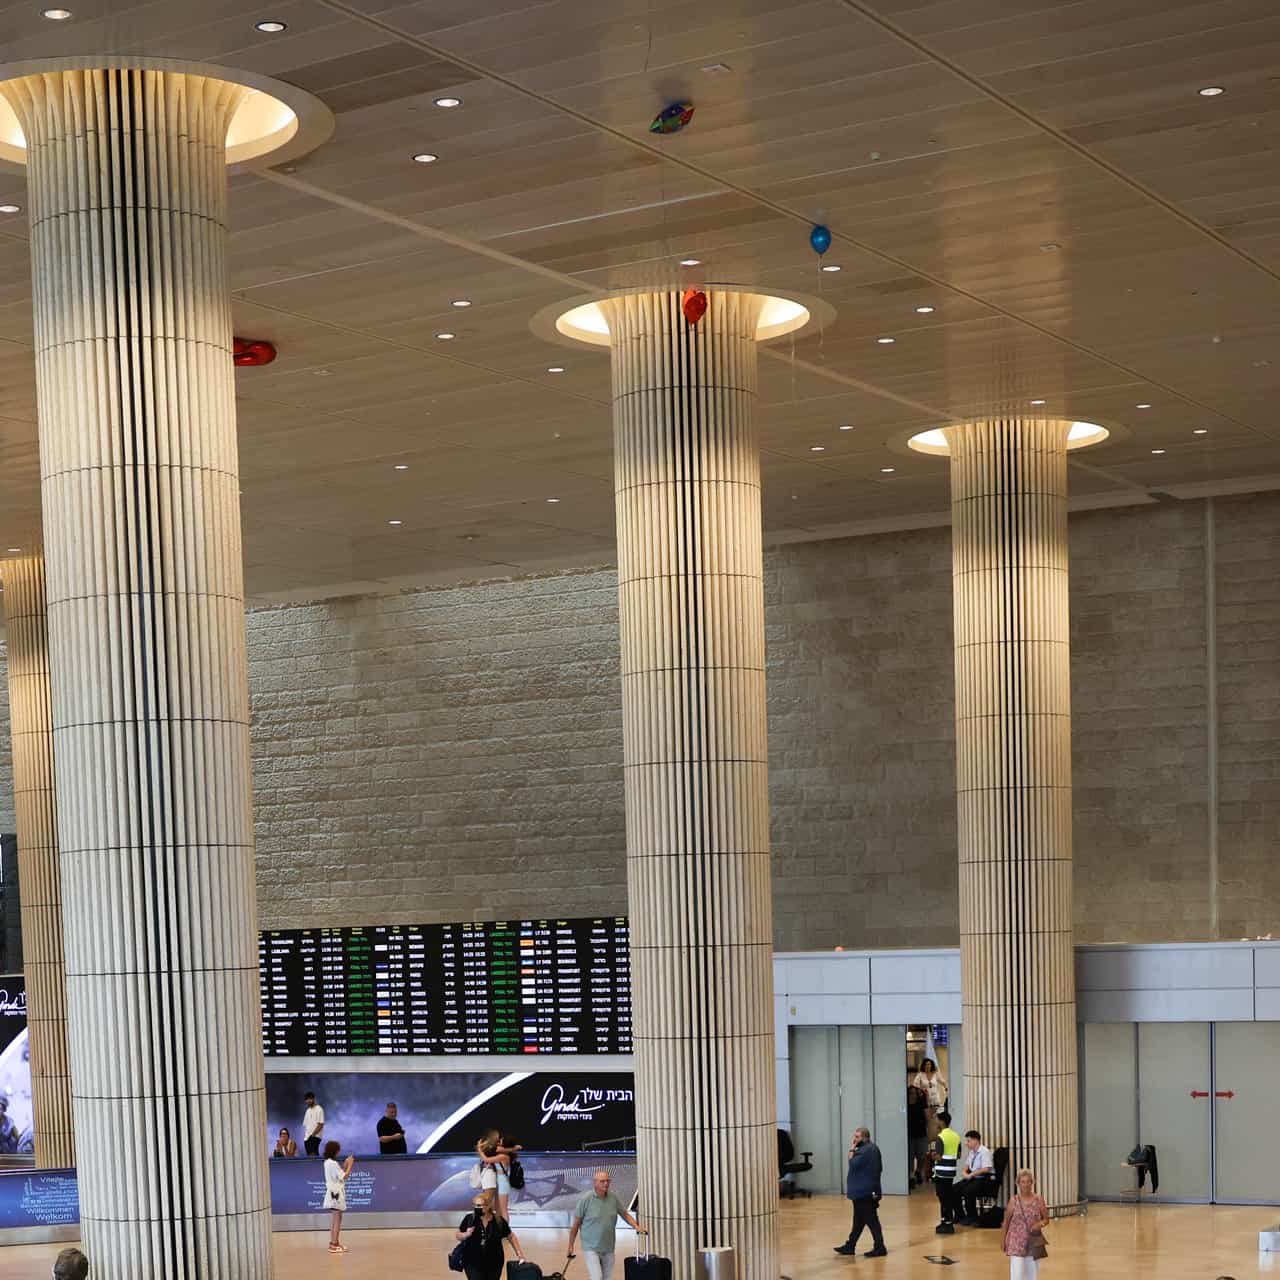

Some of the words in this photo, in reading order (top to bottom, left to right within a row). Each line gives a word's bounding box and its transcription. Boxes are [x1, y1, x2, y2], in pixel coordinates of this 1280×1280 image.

[579, 1087, 603, 1104] שלך
[606, 1089, 633, 1101] הבית
[34, 1213, 73, 1221] Welkom
